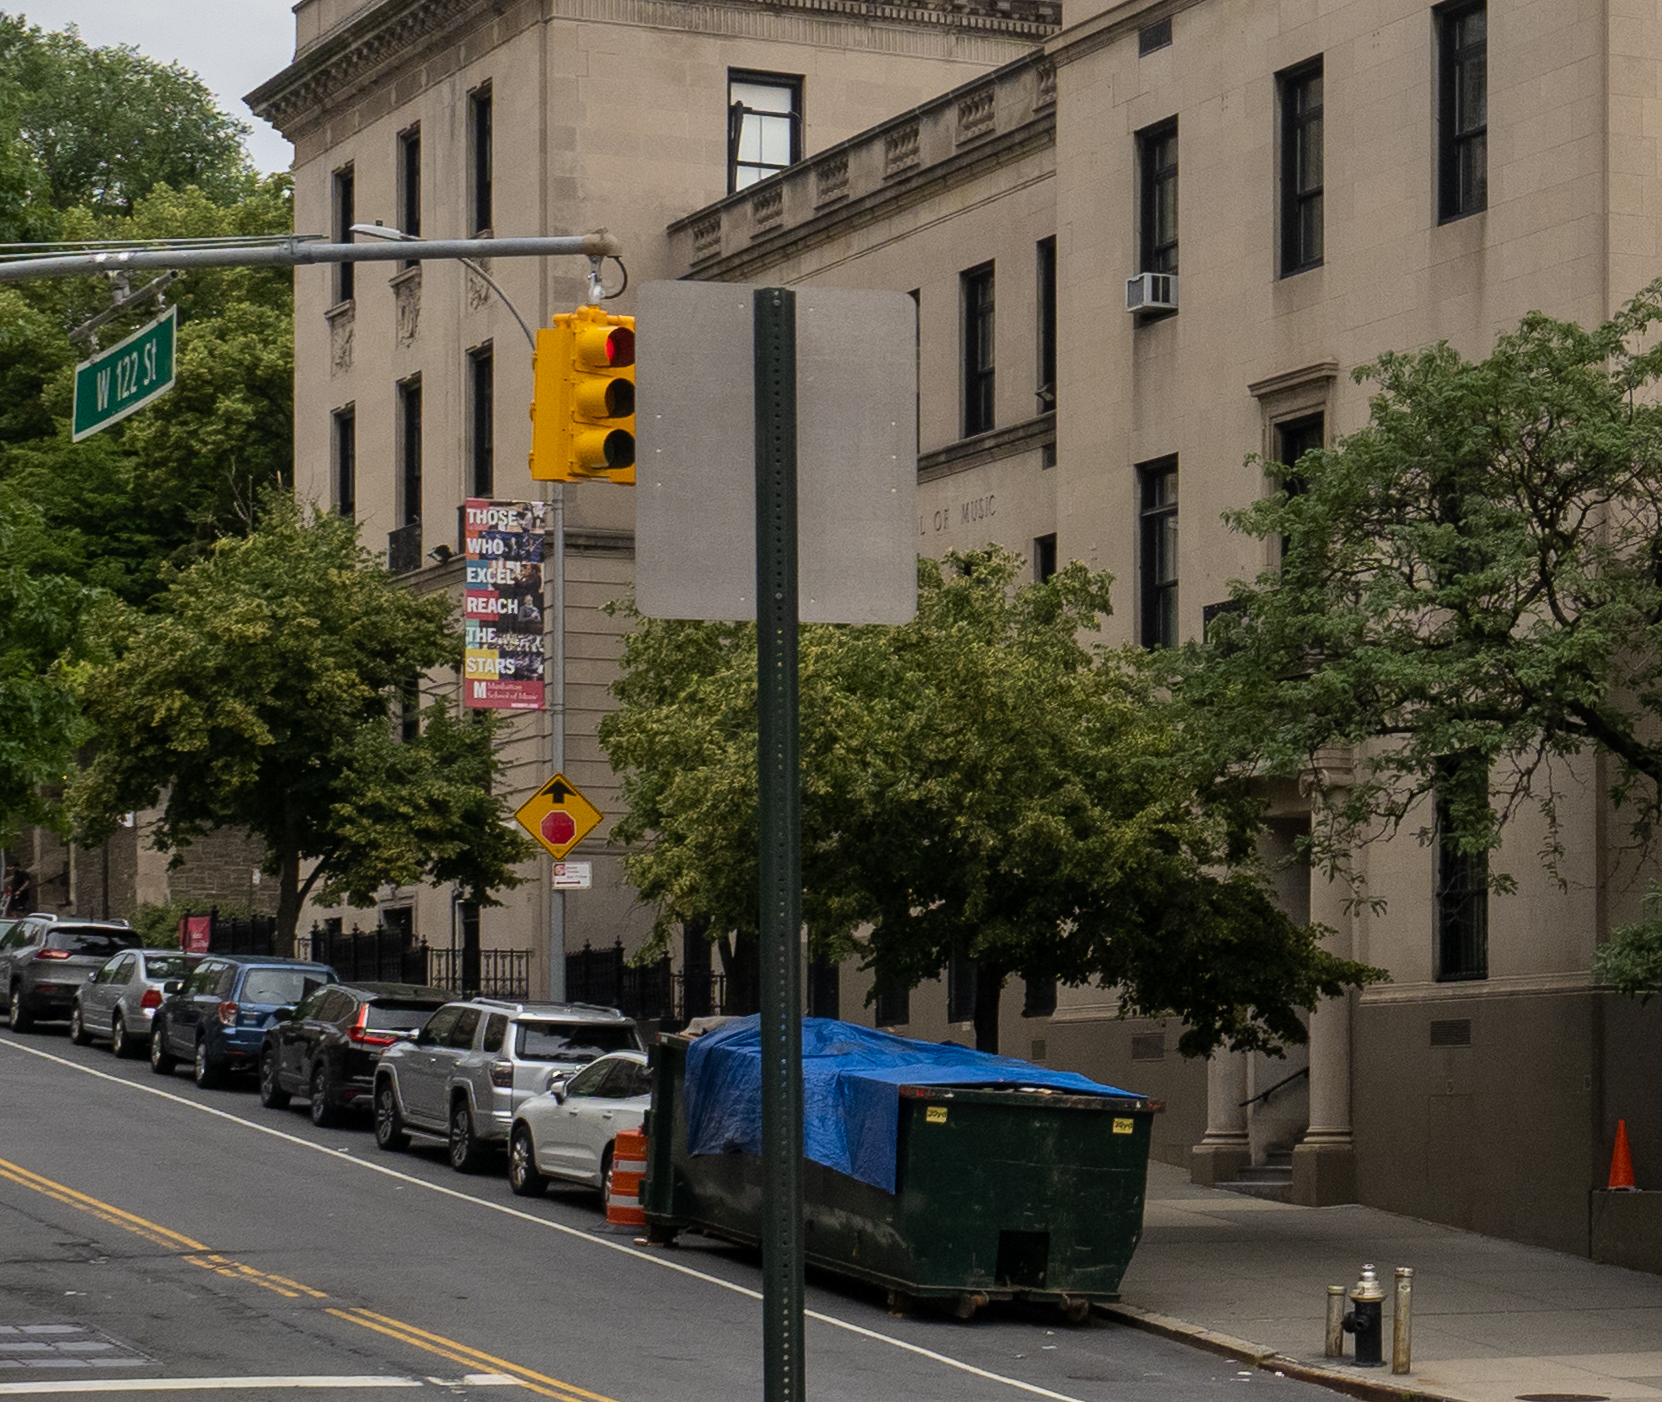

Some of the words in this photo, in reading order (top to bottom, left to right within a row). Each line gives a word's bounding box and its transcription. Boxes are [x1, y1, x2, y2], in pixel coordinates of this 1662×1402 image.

[97, 367, 111, 412] W
[116, 351, 138, 402] 122
[143, 338, 157, 386] St
[467, 508, 518, 526] THOSE
[934, 508, 949, 532] OF
[961, 494, 996, 525] MUSIC
[467, 538, 504, 555] WHO
[467, 567, 515, 585] EXCEL
[467, 597, 518, 614] REACH
[466, 627, 497, 643] THE
[466, 657, 515, 675] STARS
[473, 681, 487, 698] M
